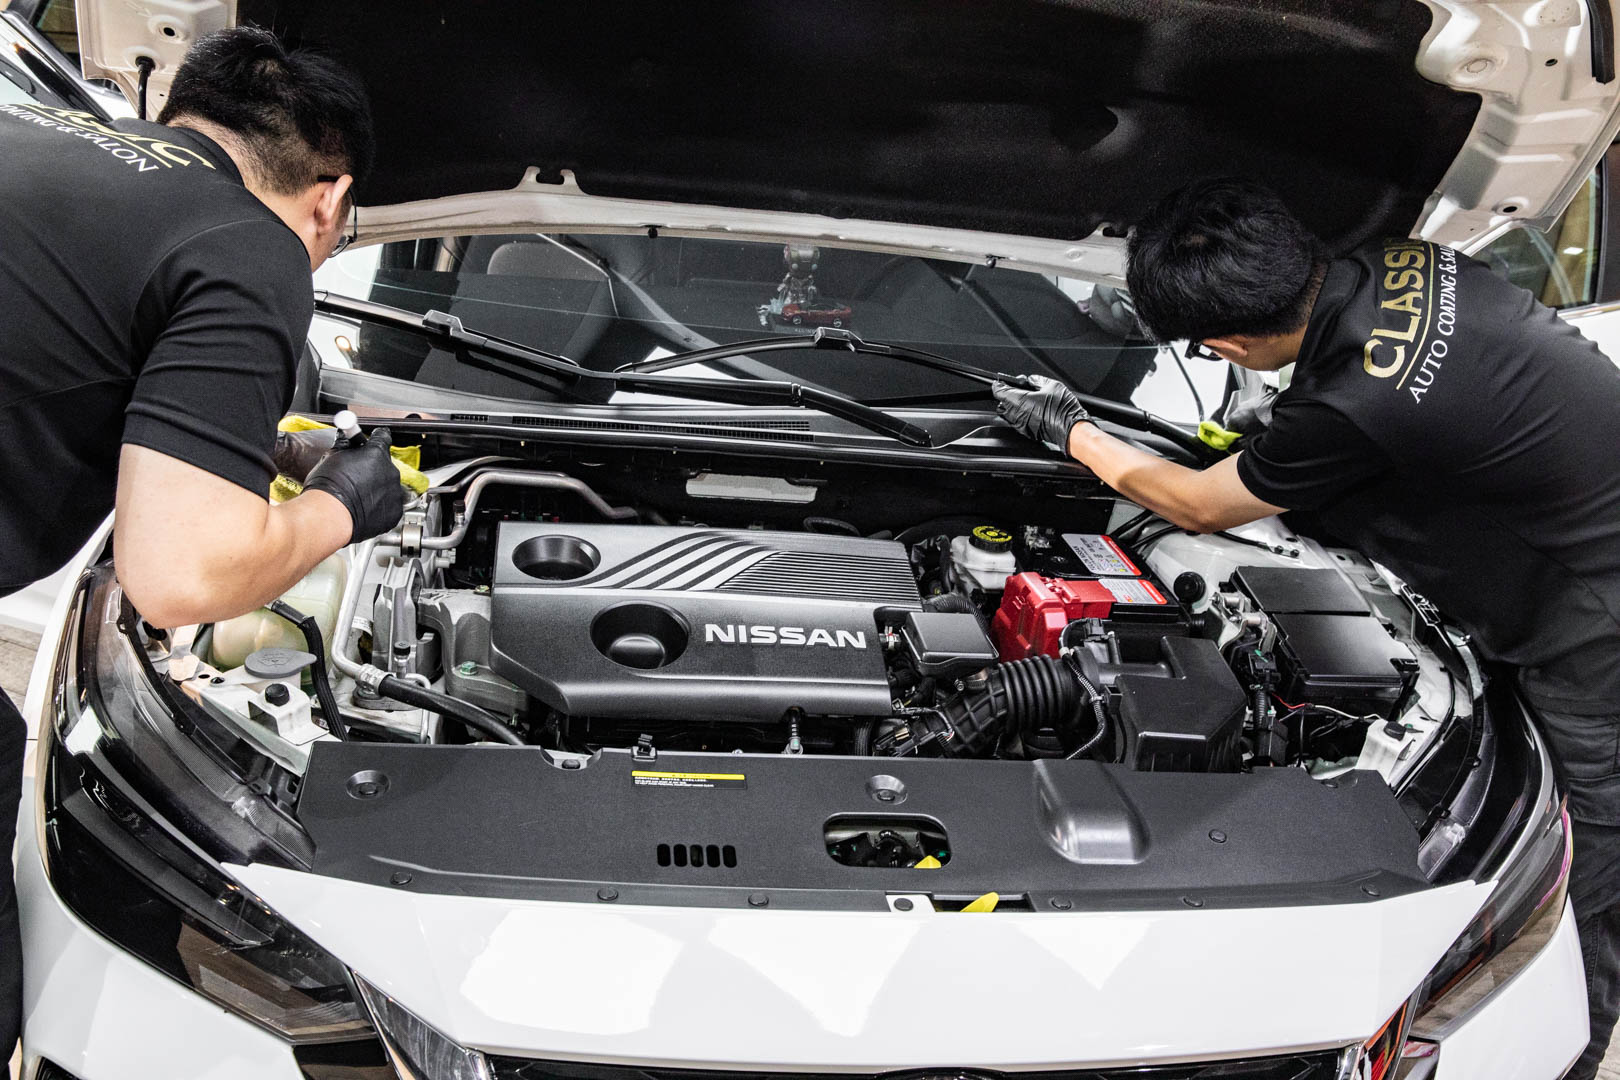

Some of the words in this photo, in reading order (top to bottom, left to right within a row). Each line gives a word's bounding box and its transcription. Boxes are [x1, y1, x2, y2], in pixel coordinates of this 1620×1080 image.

[74, 131, 159, 173] SALON
[1438, 263, 1457, 274] &
[1437, 274, 1457, 336] COATING
[1409, 339, 1449, 404] AUTO
[704, 623, 867, 649] NISSAN
